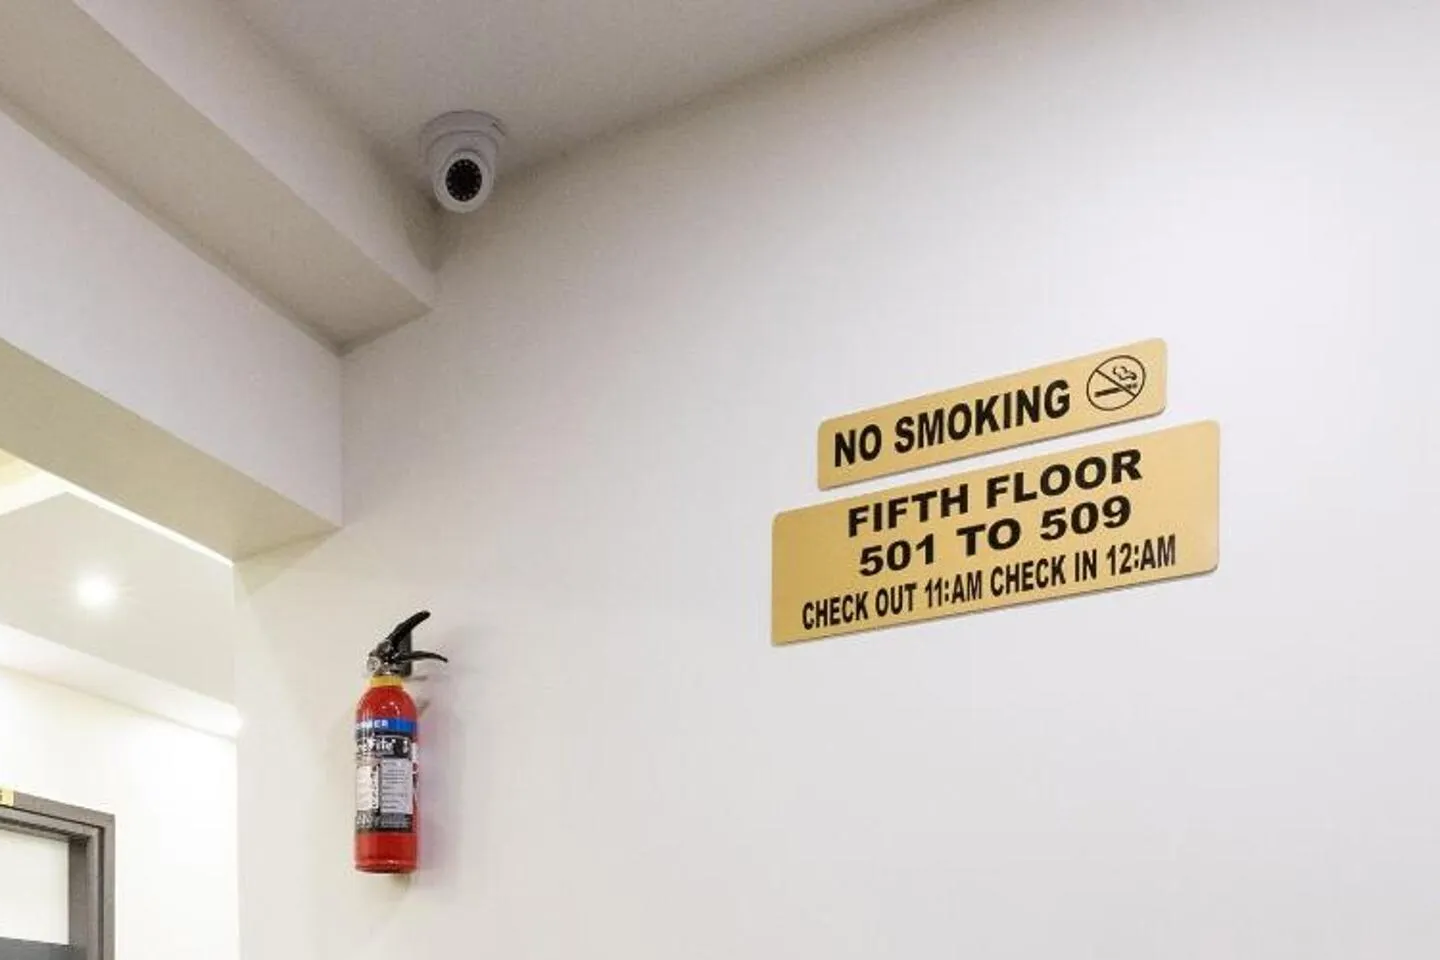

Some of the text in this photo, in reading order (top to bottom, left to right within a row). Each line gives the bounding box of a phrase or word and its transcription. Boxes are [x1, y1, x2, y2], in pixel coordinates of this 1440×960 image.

[834, 379, 1071, 468] NO SMOKING
[848, 449, 1142, 538] FIFTH FLOOR
[859, 495, 1131, 577] 501 TO 509
[802, 535, 1176, 631] CHECK OUT 11:AM CHECK IN 12:AM
